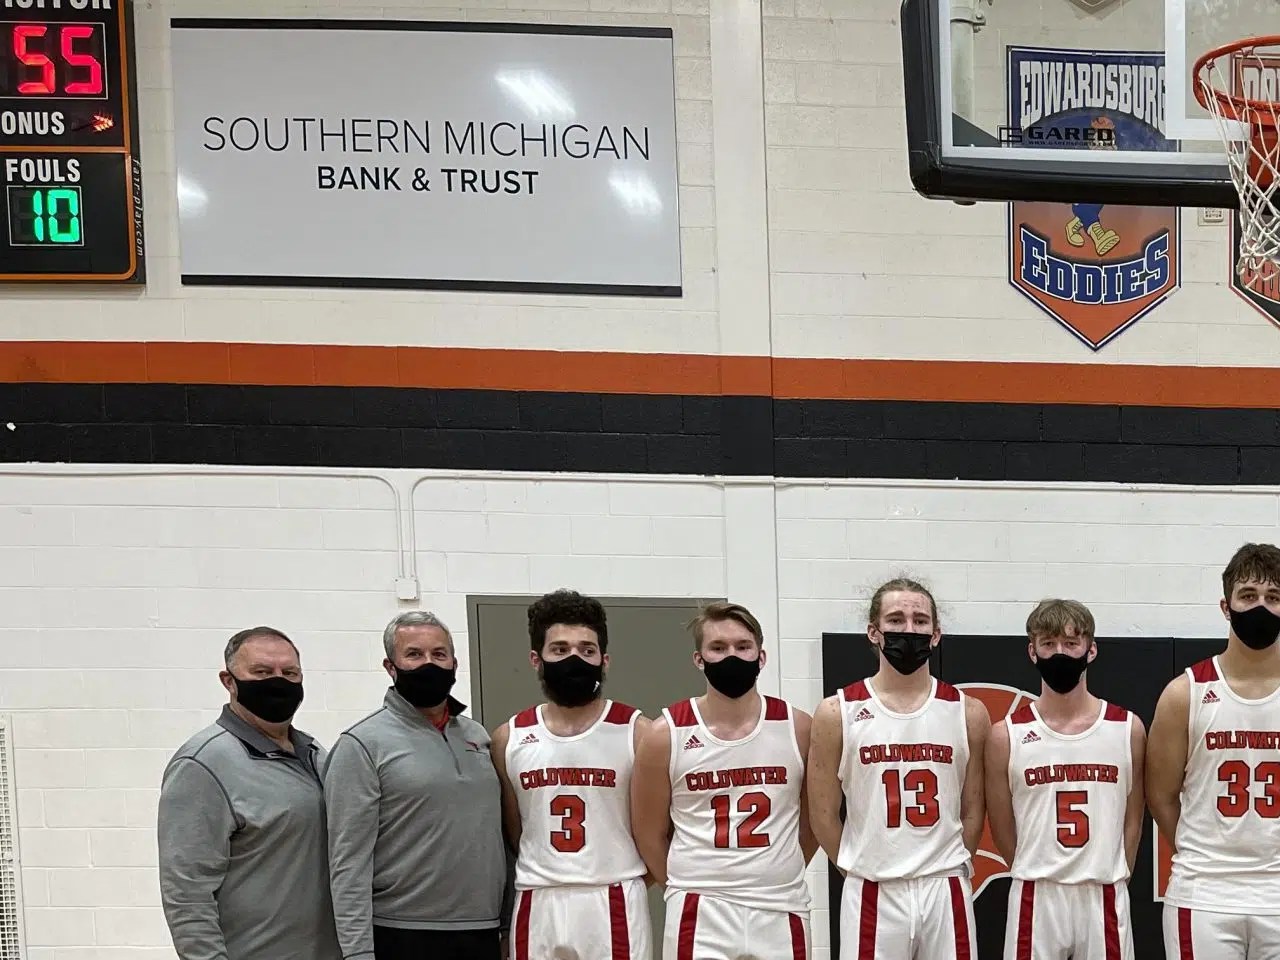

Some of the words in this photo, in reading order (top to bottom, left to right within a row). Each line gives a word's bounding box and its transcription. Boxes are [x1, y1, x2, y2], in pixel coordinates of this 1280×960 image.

[13, 25, 103, 94] 55
[203, 116, 431, 155] SOUTHERN
[444, 120, 650, 161] MICHIGAN
[1028, 127, 1113, 140] GARED
[6, 158, 81, 182] FOULS
[317, 165, 401, 192] BANK
[411, 167, 431, 192] &
[440, 168, 539, 194] TRUST
[33, 189, 80, 243] 10
[1020, 227, 1170, 305] EDDIES
[859, 743, 953, 765] COLDWATER
[1024, 764, 1119, 786] COLDWATER
[519, 767, 616, 790] COLDWATER
[685, 766, 788, 791] COLDWATER
[882, 769, 940, 828] 13
[549, 795, 586, 853] 3
[711, 792, 771, 848] 12
[1055, 790, 1090, 848] 5
